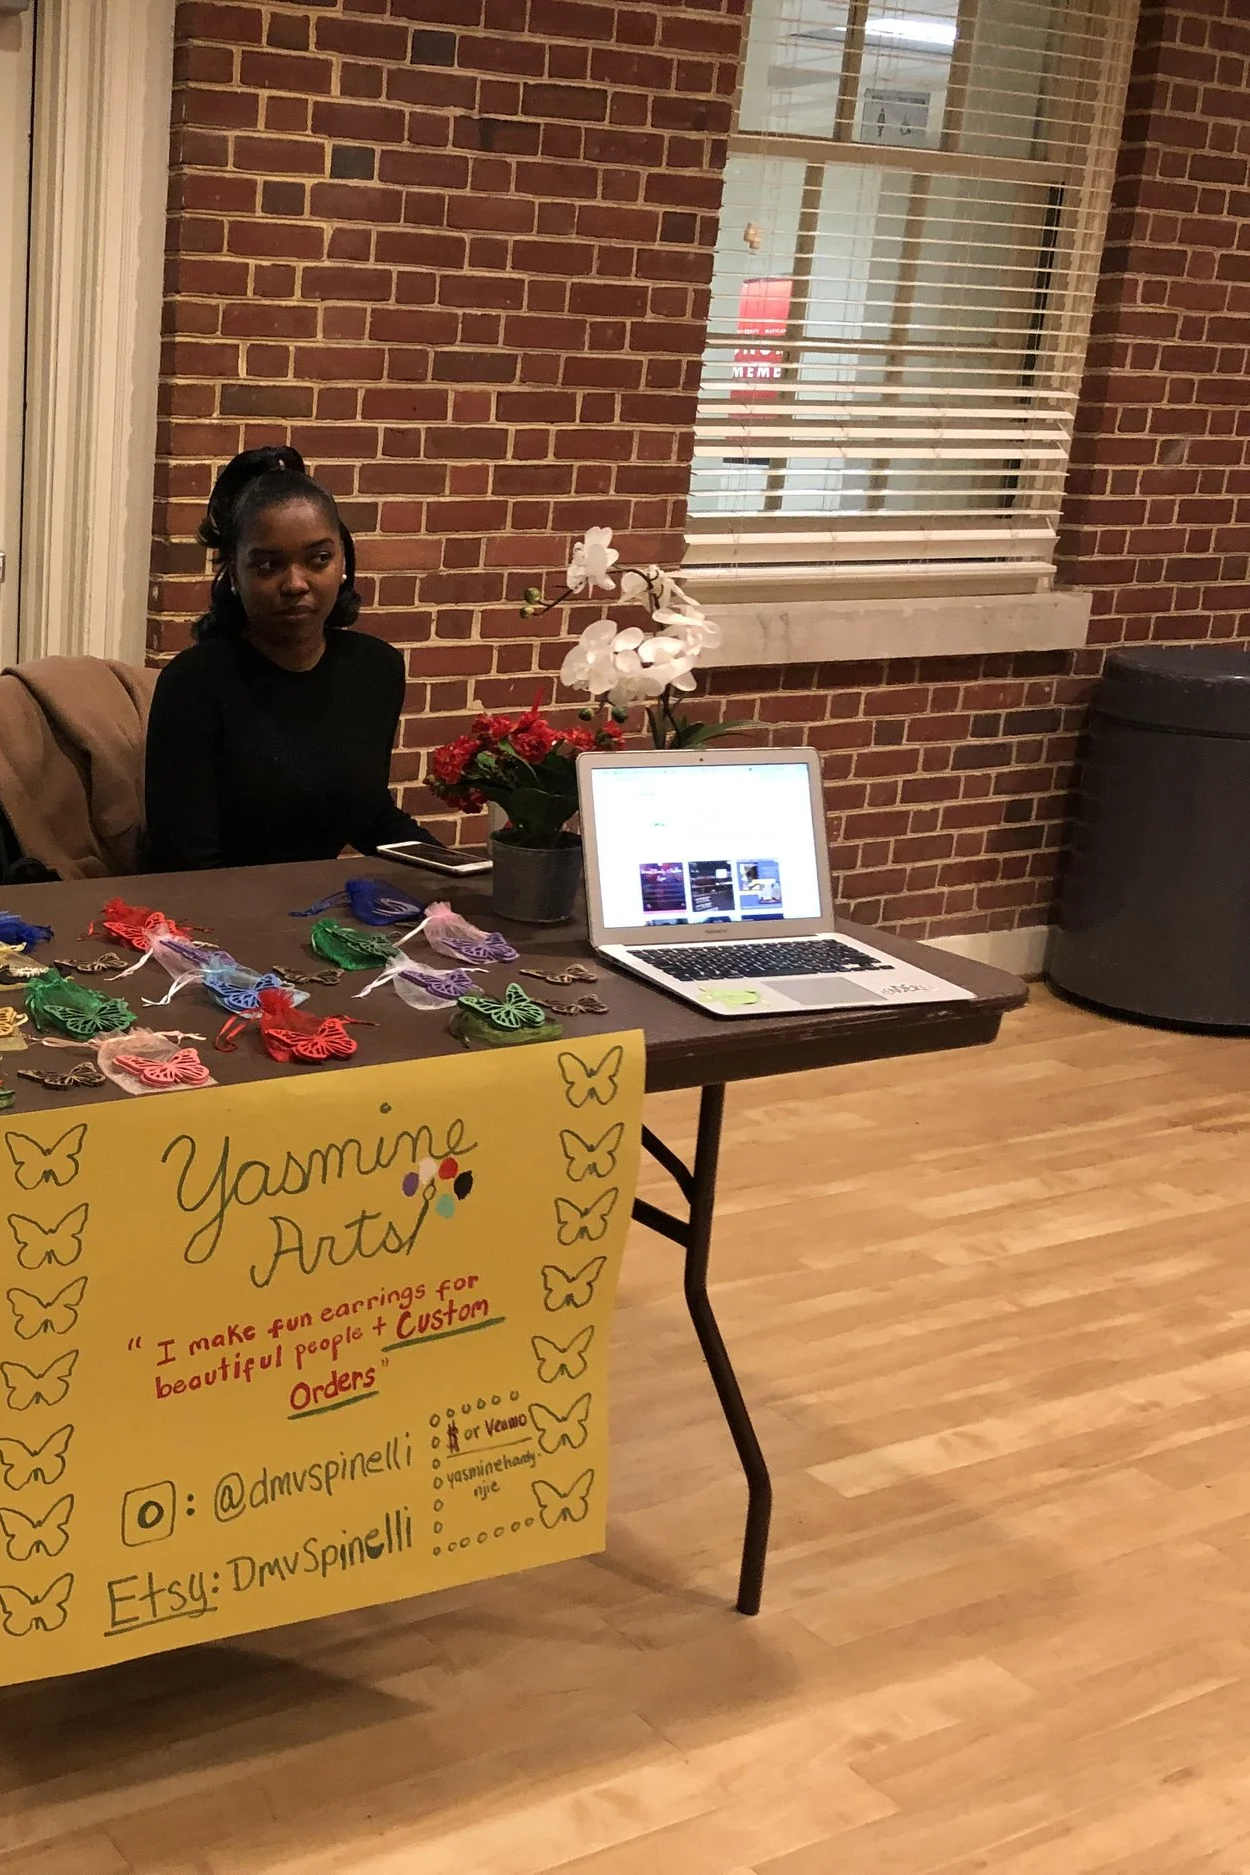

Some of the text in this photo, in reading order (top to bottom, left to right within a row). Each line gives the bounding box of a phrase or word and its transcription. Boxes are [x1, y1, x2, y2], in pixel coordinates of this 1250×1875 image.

[161, 1102, 478, 1264] Yasmine
[250, 1209, 410, 1288] Arts
[155, 1344, 283, 1399] beautiful
[295, 1326, 363, 1371] people
[396, 1298, 490, 1340] Custom
[189, 1323, 256, 1357] make
[267, 1311, 313, 1339] fun
[320, 1283, 426, 1323] earrings
[435, 1274, 480, 1302] for
[464, 1425, 481, 1441] or
[485, 1413, 528, 1438] Venmo
[213, 1431, 412, 1523] @dmvspinelli
[107, 1506, 413, 1627] Etsy: DmvSpinelli
